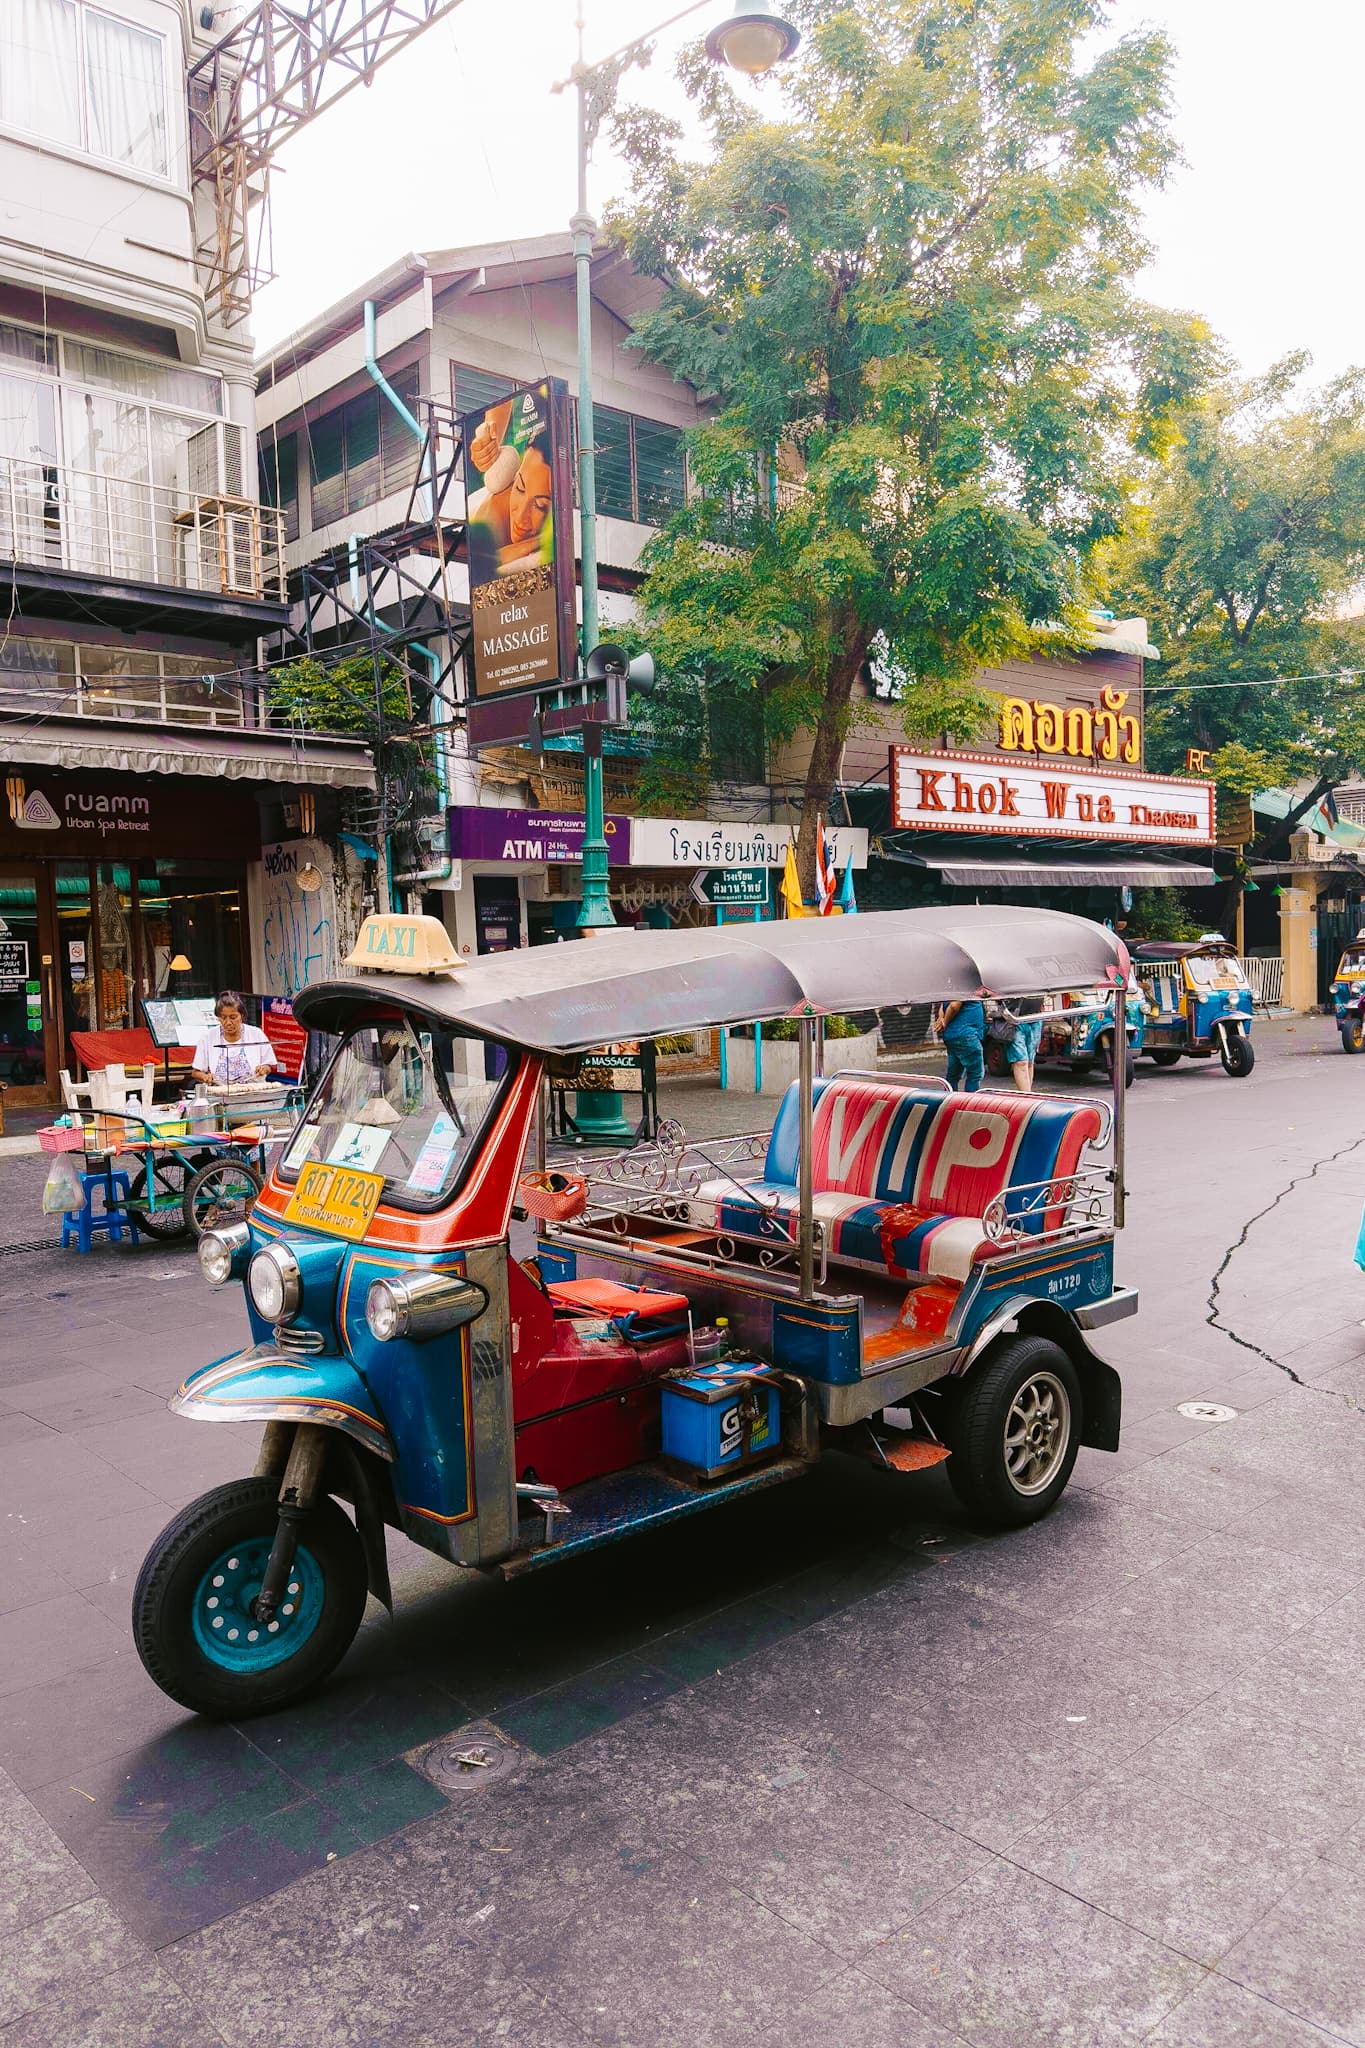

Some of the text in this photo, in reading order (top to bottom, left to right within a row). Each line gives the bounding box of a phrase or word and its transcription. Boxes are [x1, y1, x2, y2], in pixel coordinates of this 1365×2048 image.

[500, 604, 529, 625] relax
[482, 623, 549, 658] MASSAGE
[64, 793, 150, 815] ruamm
[917, 768, 1199, 829] Khok Wua Khaosan
[66, 816, 151, 838] Urban Spa Retreat
[502, 839, 543, 860] ATM
[547, 842, 556, 850] 24
[556, 841, 569, 850] Hrs.
[722, 870, 753, 881] โรงเรียน
[712, 880, 763, 894] พิมานวิทย์
[366, 924, 418, 958] TAXI
[591, 1056, 636, 1067] MASSAGE
[828, 1095, 1010, 1200] VIP
[332, 1174, 377, 1210] 1720
